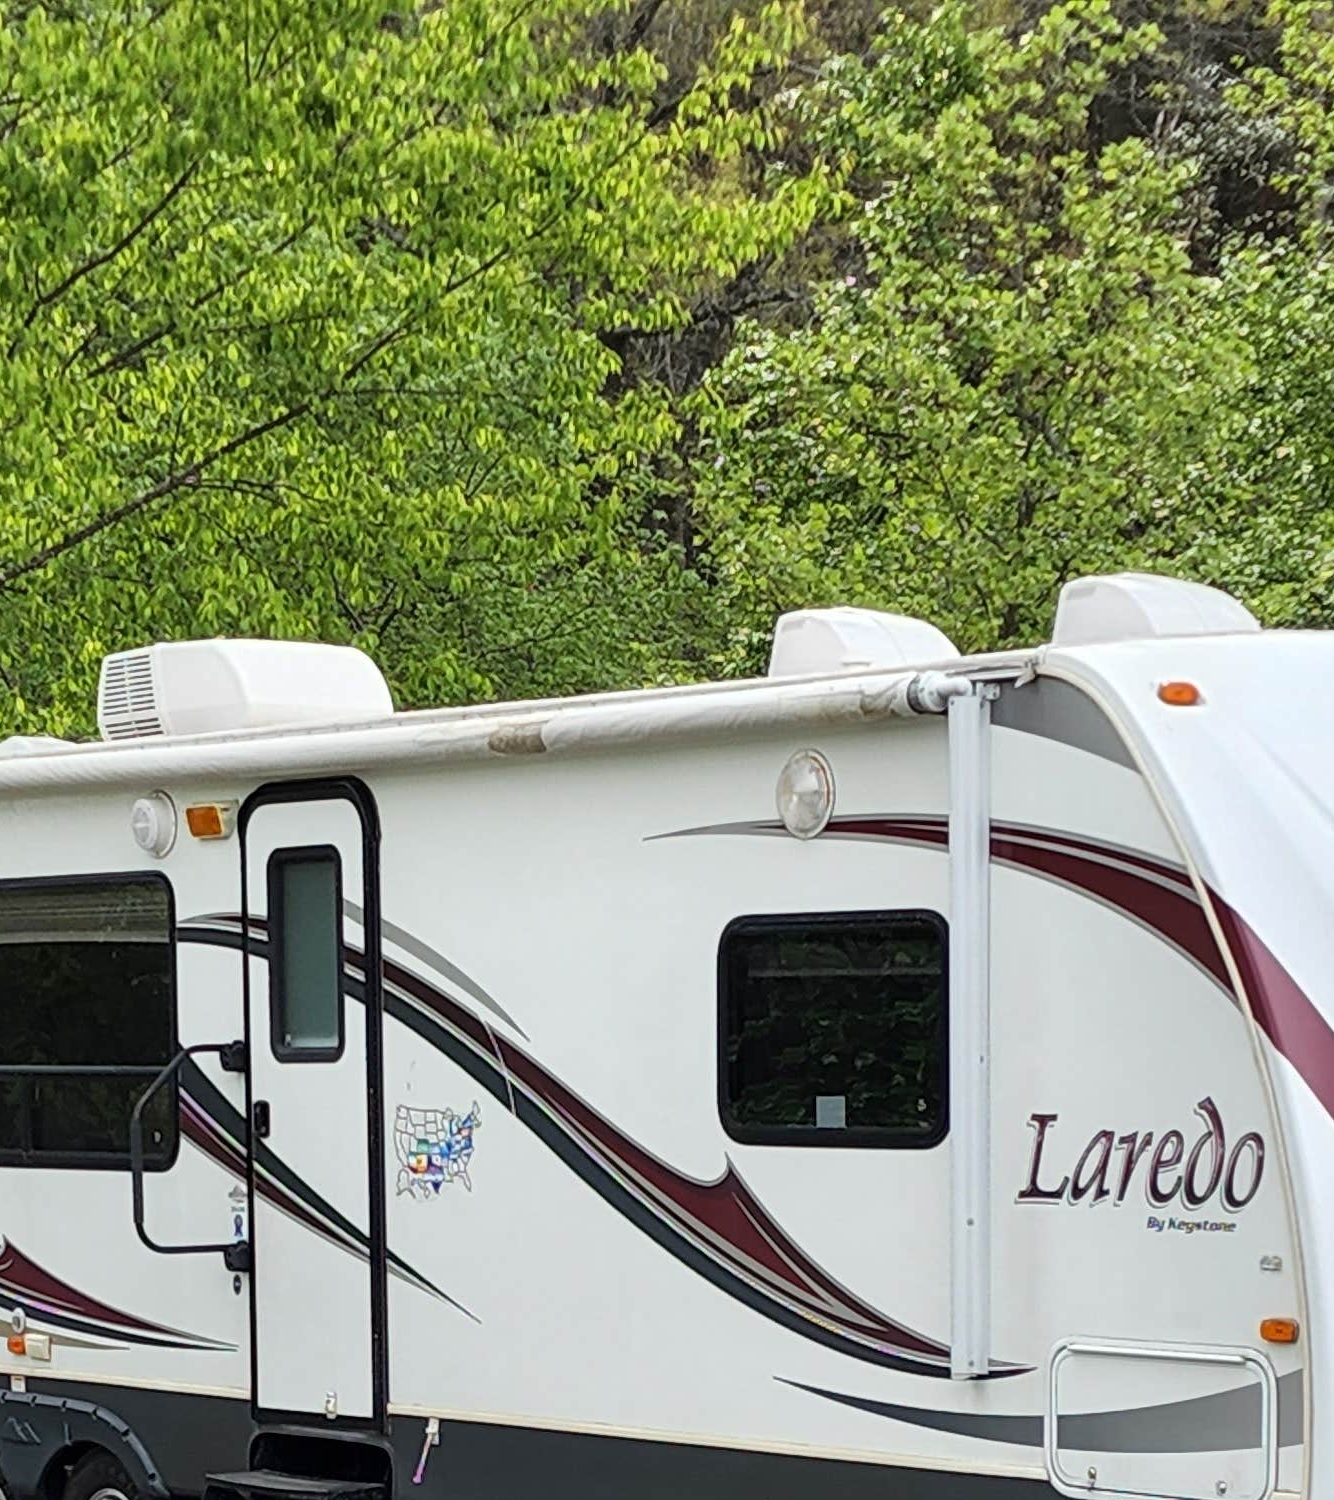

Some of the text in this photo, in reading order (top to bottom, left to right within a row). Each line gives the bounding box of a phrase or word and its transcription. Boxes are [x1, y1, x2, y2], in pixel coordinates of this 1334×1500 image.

[1015, 1096, 1266, 1213] Laredo
[1147, 1216, 1237, 1234] By Keystone
